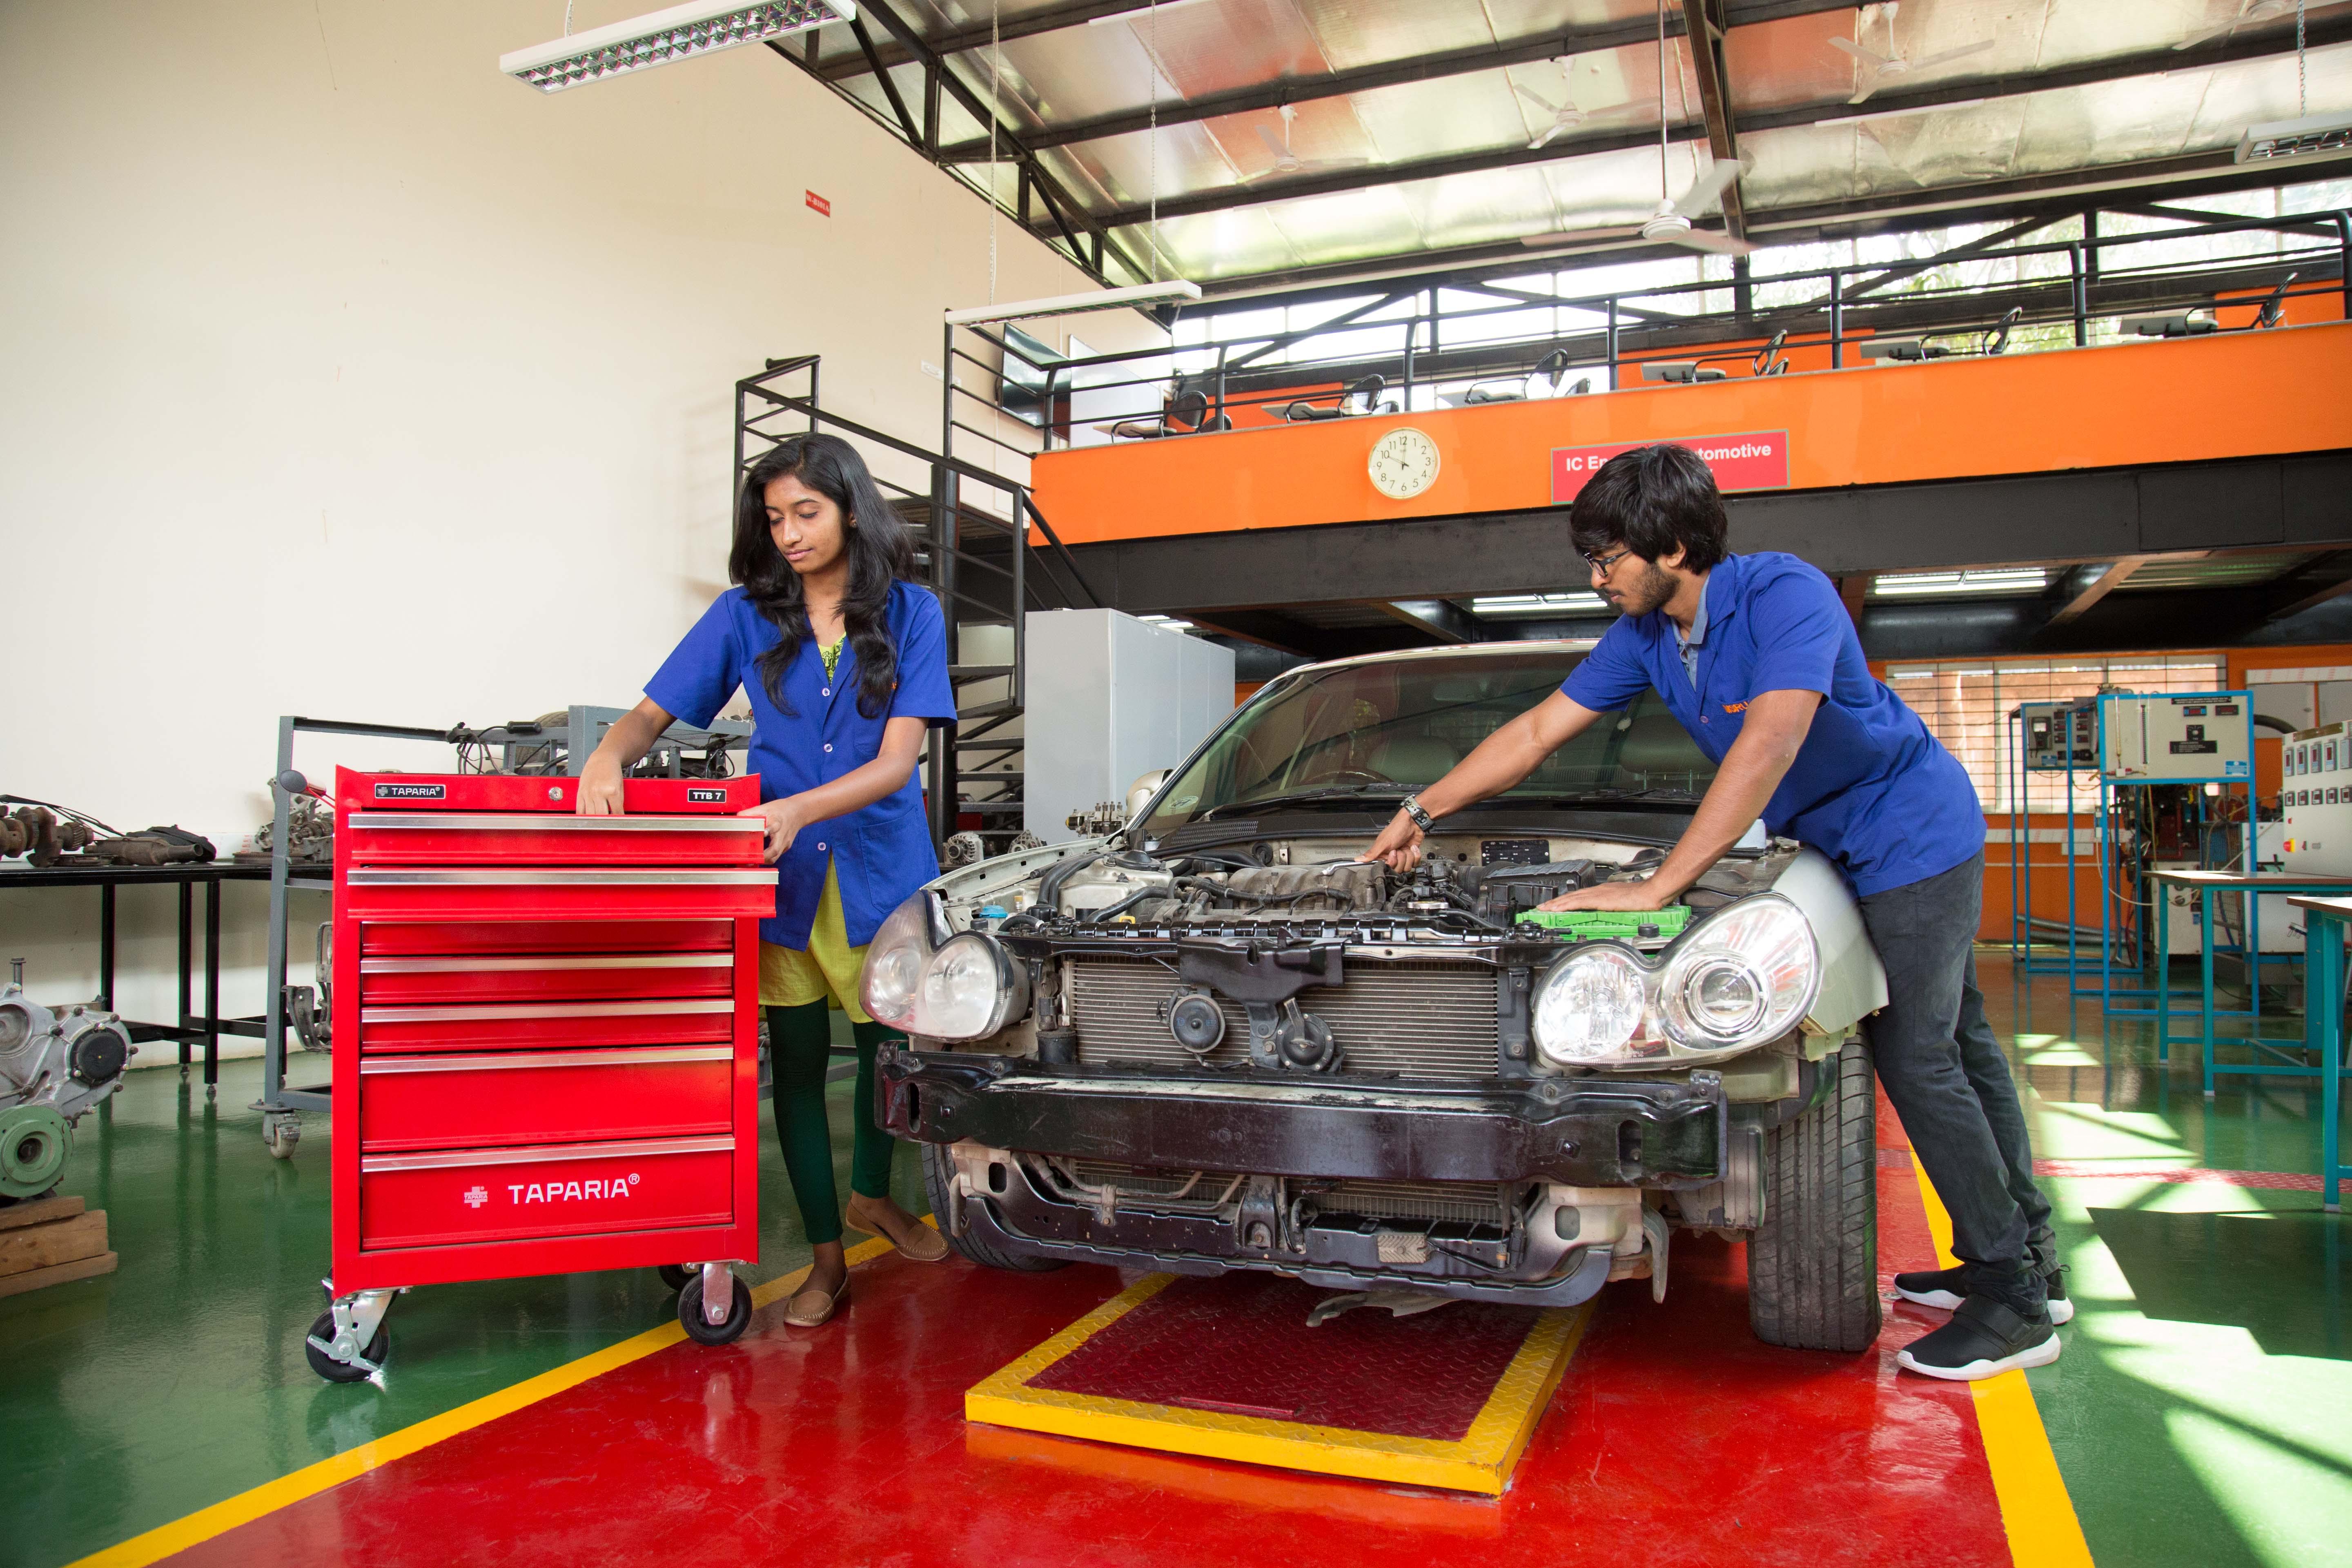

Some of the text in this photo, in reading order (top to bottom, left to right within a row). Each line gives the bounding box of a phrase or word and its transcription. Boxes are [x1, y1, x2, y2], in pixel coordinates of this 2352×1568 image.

[1399, 436, 1407, 445] 12
[1413, 438, 1416, 447] 1
[1389, 441, 1396, 450] 11
[1421, 445, 1426, 454] 2
[1381, 450, 1390, 459] 10
[1566, 443, 1771, 471] IC En tomotive
[1376, 461, 1382, 470] 9
[1425, 457, 1431, 466] 3
[1381, 473, 1386, 481] 8
[1390, 480, 1395, 489] 7
[1401, 482, 1407, 491] 6
[1413, 479, 1419, 487] 5
